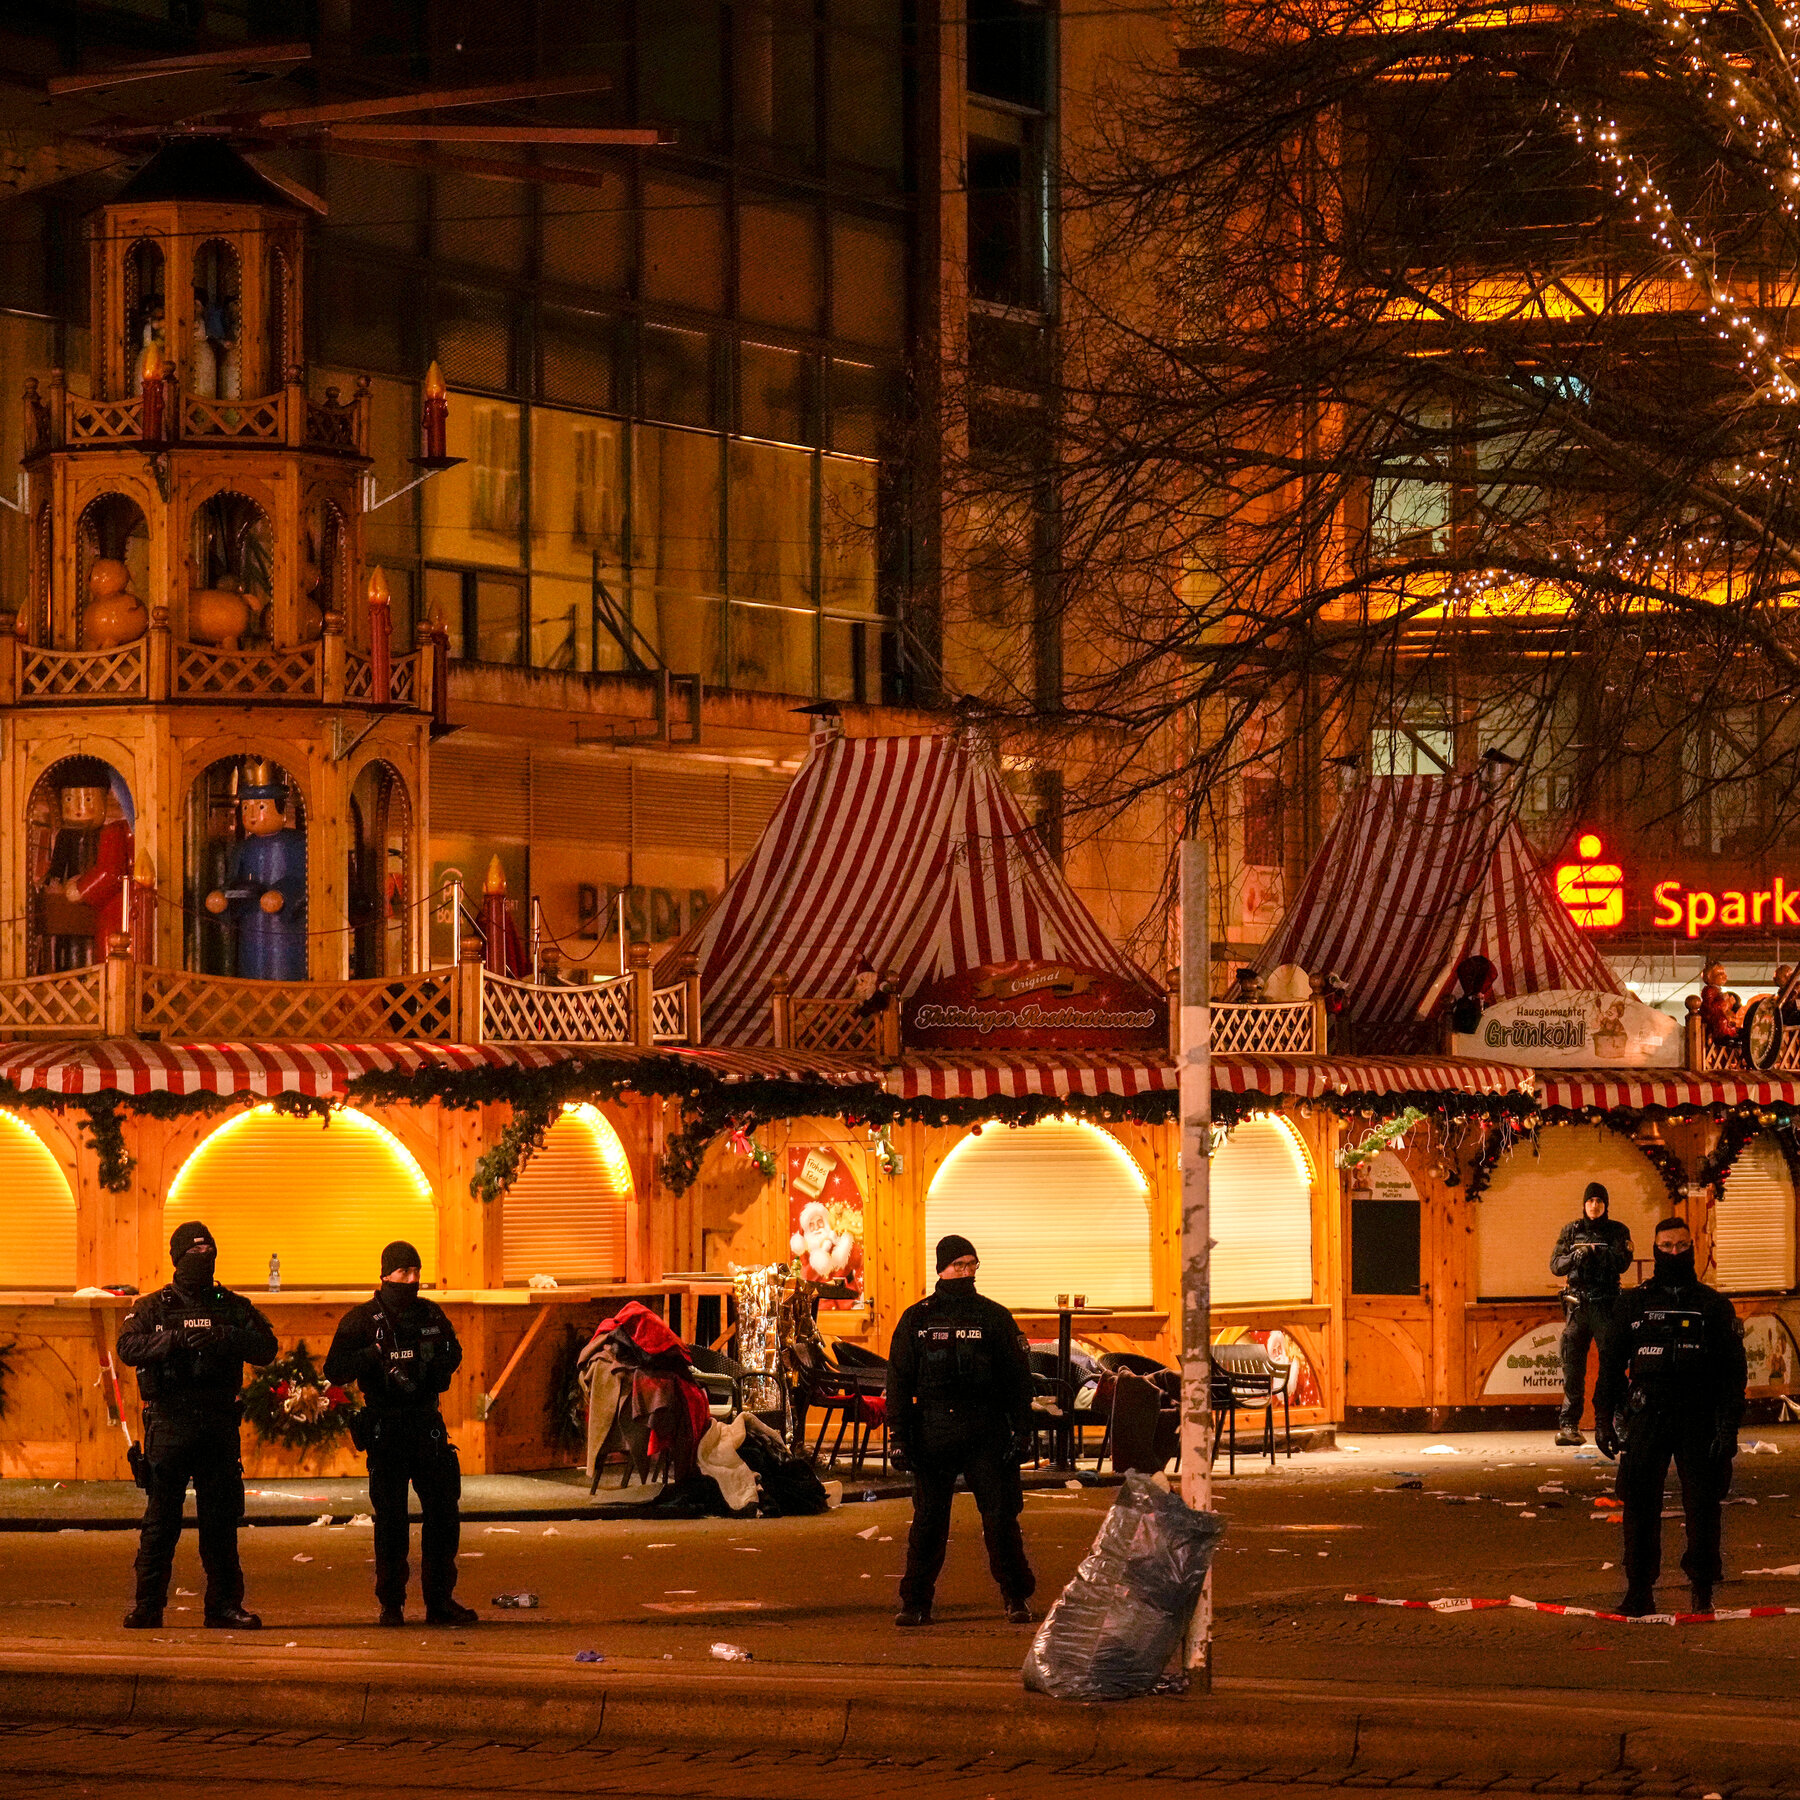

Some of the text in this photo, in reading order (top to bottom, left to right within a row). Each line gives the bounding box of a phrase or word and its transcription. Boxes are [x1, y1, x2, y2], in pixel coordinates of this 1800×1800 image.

[1654, 877, 1800, 938] Spark
[1011, 970, 1060, 992] Original
[1015, 1004, 1156, 1028] Rostbratwurst
[1516, 1006, 1587, 1018] Hausgemachter
[1485, 1018, 1586, 1048] Grünkohl
[184, 1319, 211, 1328] POLIZEI
[1638, 1346, 1664, 1355] POLIZEI
[1523, 1375, 1565, 1387] Muttern
